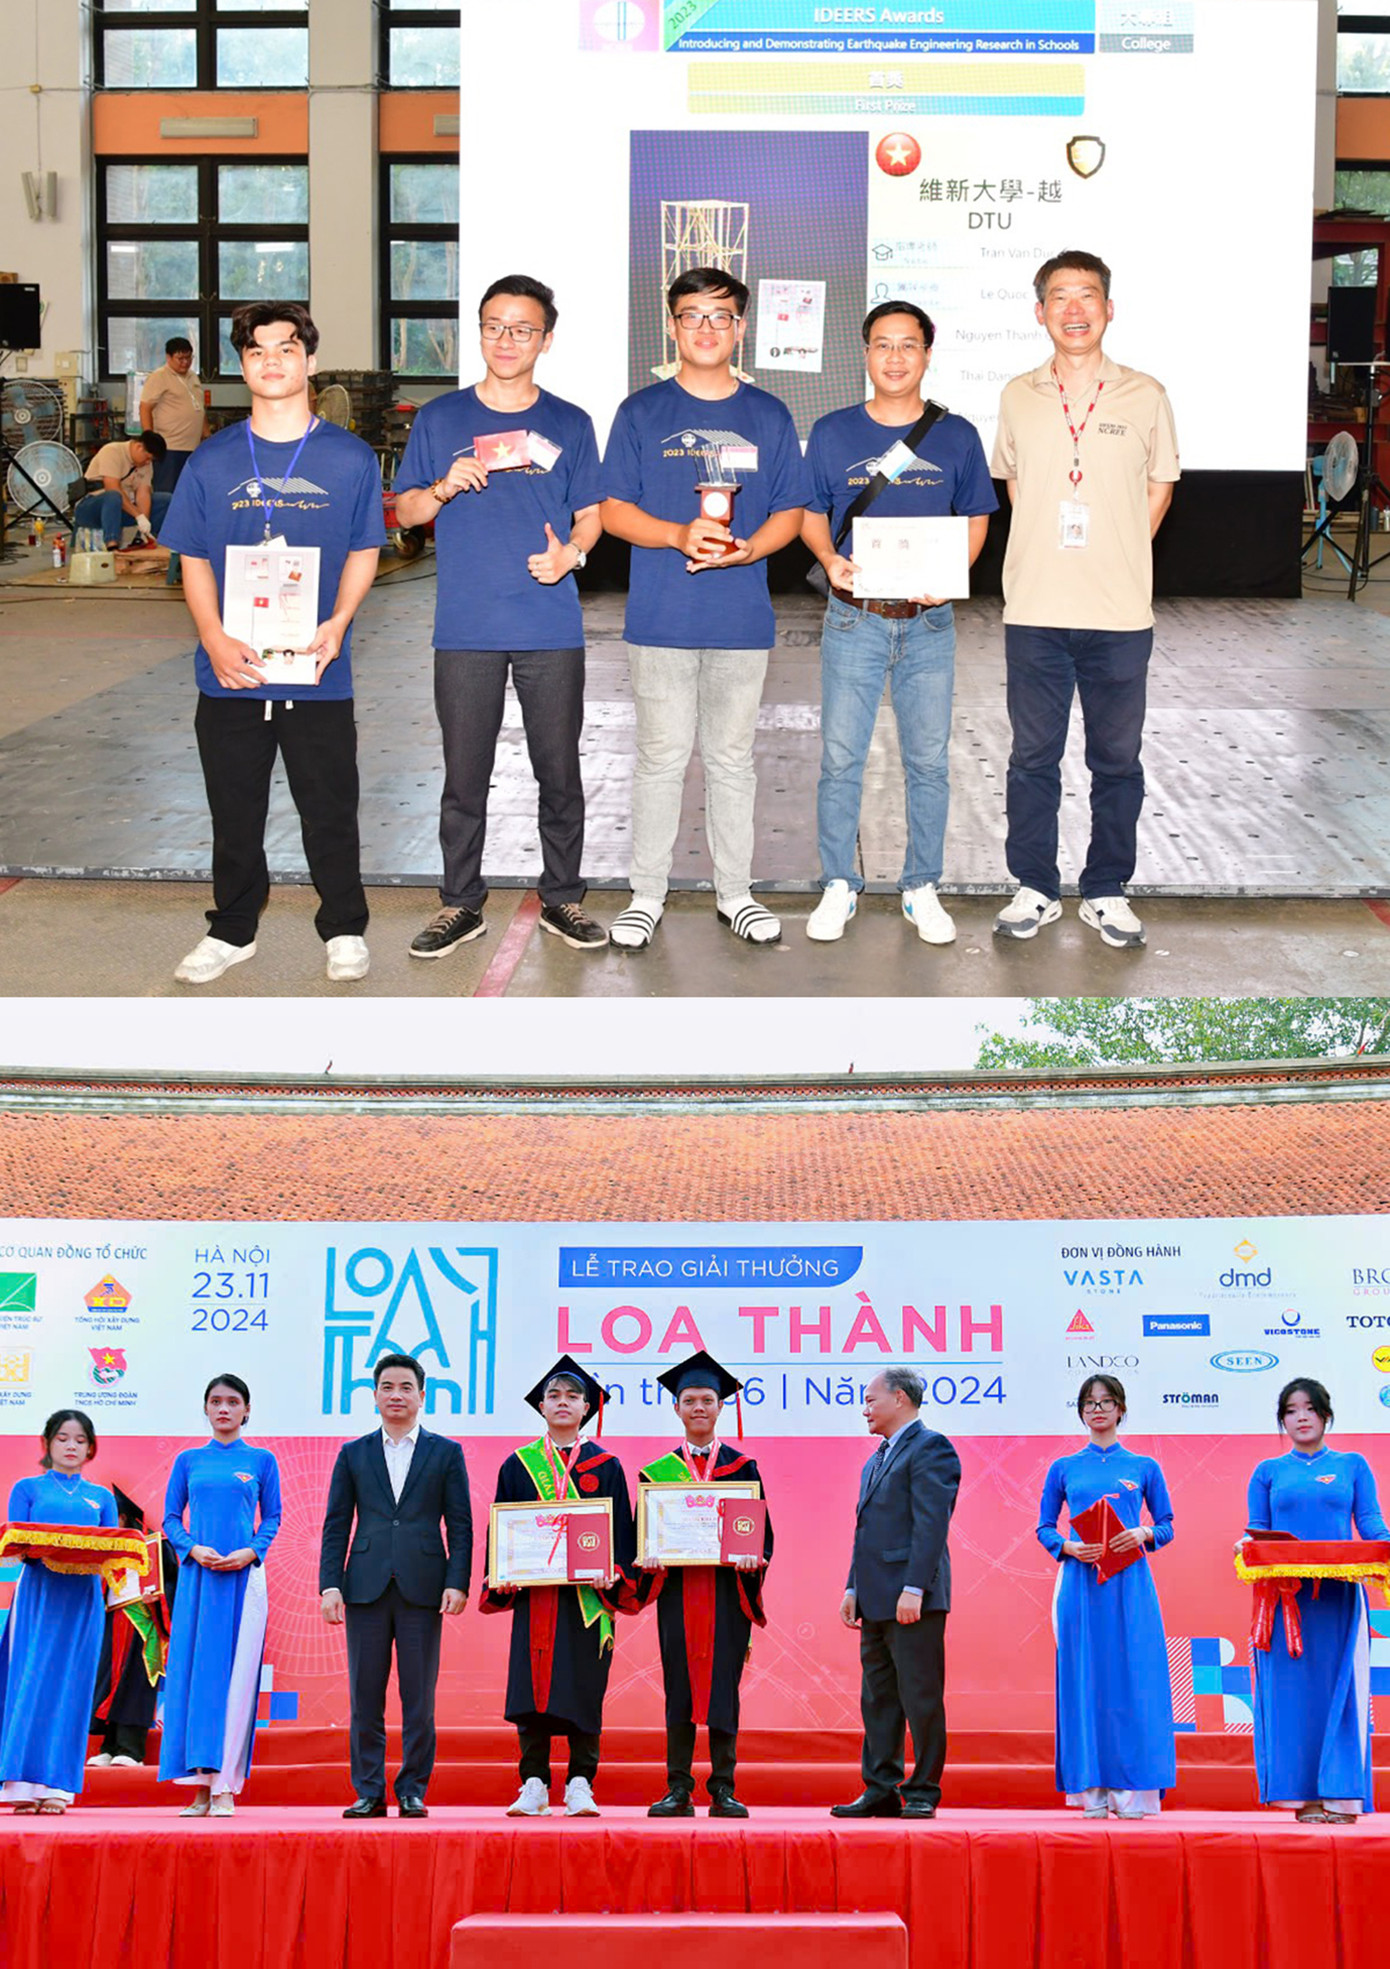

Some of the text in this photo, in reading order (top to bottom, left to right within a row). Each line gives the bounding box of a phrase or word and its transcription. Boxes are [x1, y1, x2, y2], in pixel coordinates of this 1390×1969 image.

[668, 1, 698, 30] 2023
[813, 8, 945, 24] IDEERS Awards
[678, 38, 1080, 53] Introducing and Demonstrating Earthquake Engineering Research in Schools
[1121, 37, 1172, 53] College
[855, 99, 917, 114] First Prize
[919, 178, 1063, 203] 維新大學-越
[968, 212, 1013, 230] DTU
[980, 247, 1005, 259] Tran
[1008, 247, 1031, 259] Van
[980, 289, 1029, 302] Le Quoc
[955, 329, 1043, 343] Nguyen Thanh
[960, 370, 984, 381] Thai
[18, 1247, 52, 1259] QUAN
[57, 1245, 92, 1259] ĐỒNG
[97, 1243, 111, 1259] TỔ
[114, 1246, 148, 1259] CHỨC
[195, 1245, 270, 1267] HÀ NỘI
[1061, 1243, 1181, 1260] ĐƠN VỊ ĐỒNG HÀNH
[573, 1253, 839, 1277] LỄ TRAO GIẢI THƯỞNG
[1064, 1270, 1144, 1286] VASTA
[1219, 1267, 1272, 1287] dmd
[192, 1272, 270, 1299] 23.11
[191, 1308, 269, 1331] 2024
[557, 1290, 1004, 1354] LOA THÀNH
[1150, 1321, 1202, 1331] Panasonic
[1264, 1328, 1320, 1336] VICOSTONE
[1067, 1355, 1140, 1368] LANDCO
[1226, 1357, 1264, 1366] SEEN
